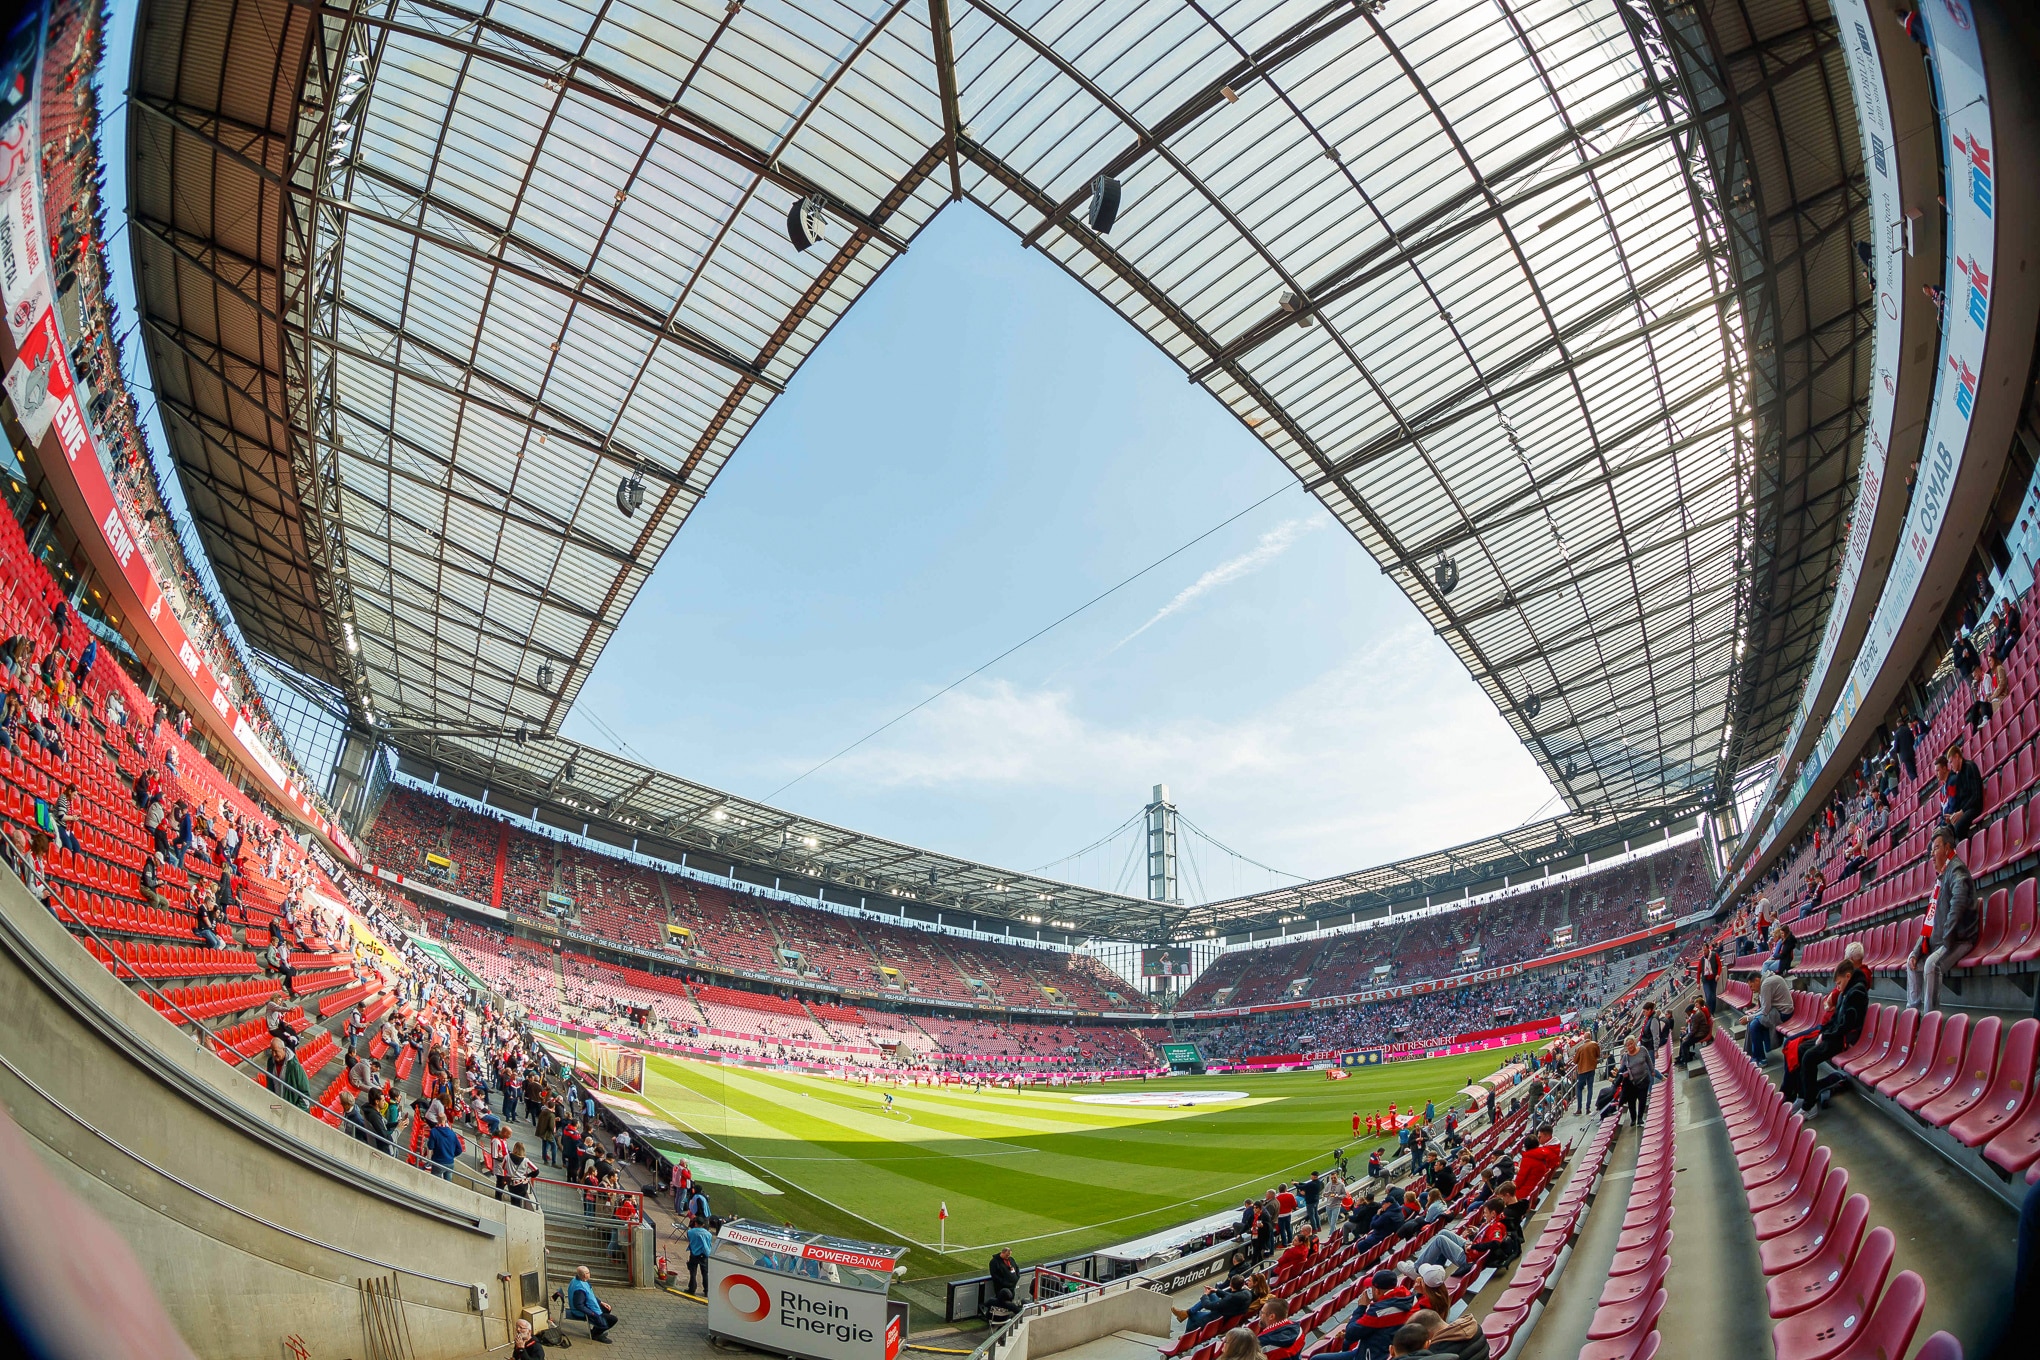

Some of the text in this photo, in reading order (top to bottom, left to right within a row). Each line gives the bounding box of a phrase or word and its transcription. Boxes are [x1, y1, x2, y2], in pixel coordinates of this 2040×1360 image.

[20, 177, 39, 275] KÖLSCHE KLÜNGEL
[0, 214, 17, 291] MÖHNETAL
[55, 394, 87, 461] EWE
[1921, 441, 1953, 535] OSMAB
[103, 507, 134, 567] REWE
[178, 640, 201, 678] REWE
[516, 916, 559, 934] POLI-TAPE
[696, 961, 735, 975] POLI-TAPE
[1310, 987, 1413, 1010] SÜDKURVE
[1472, 962, 1524, 984] KÖLN
[1301, 1053, 1312, 1062] FC
[1407, 1036, 1458, 1051] RESIGNIERT
[728, 1230, 798, 1253] RheinEnergie
[807, 1248, 883, 1268] POWERBANK
[1171, 1266, 1210, 1289] Partner
[780, 1290, 849, 1320] Rhein
[780, 1309, 873, 1343] Energie
